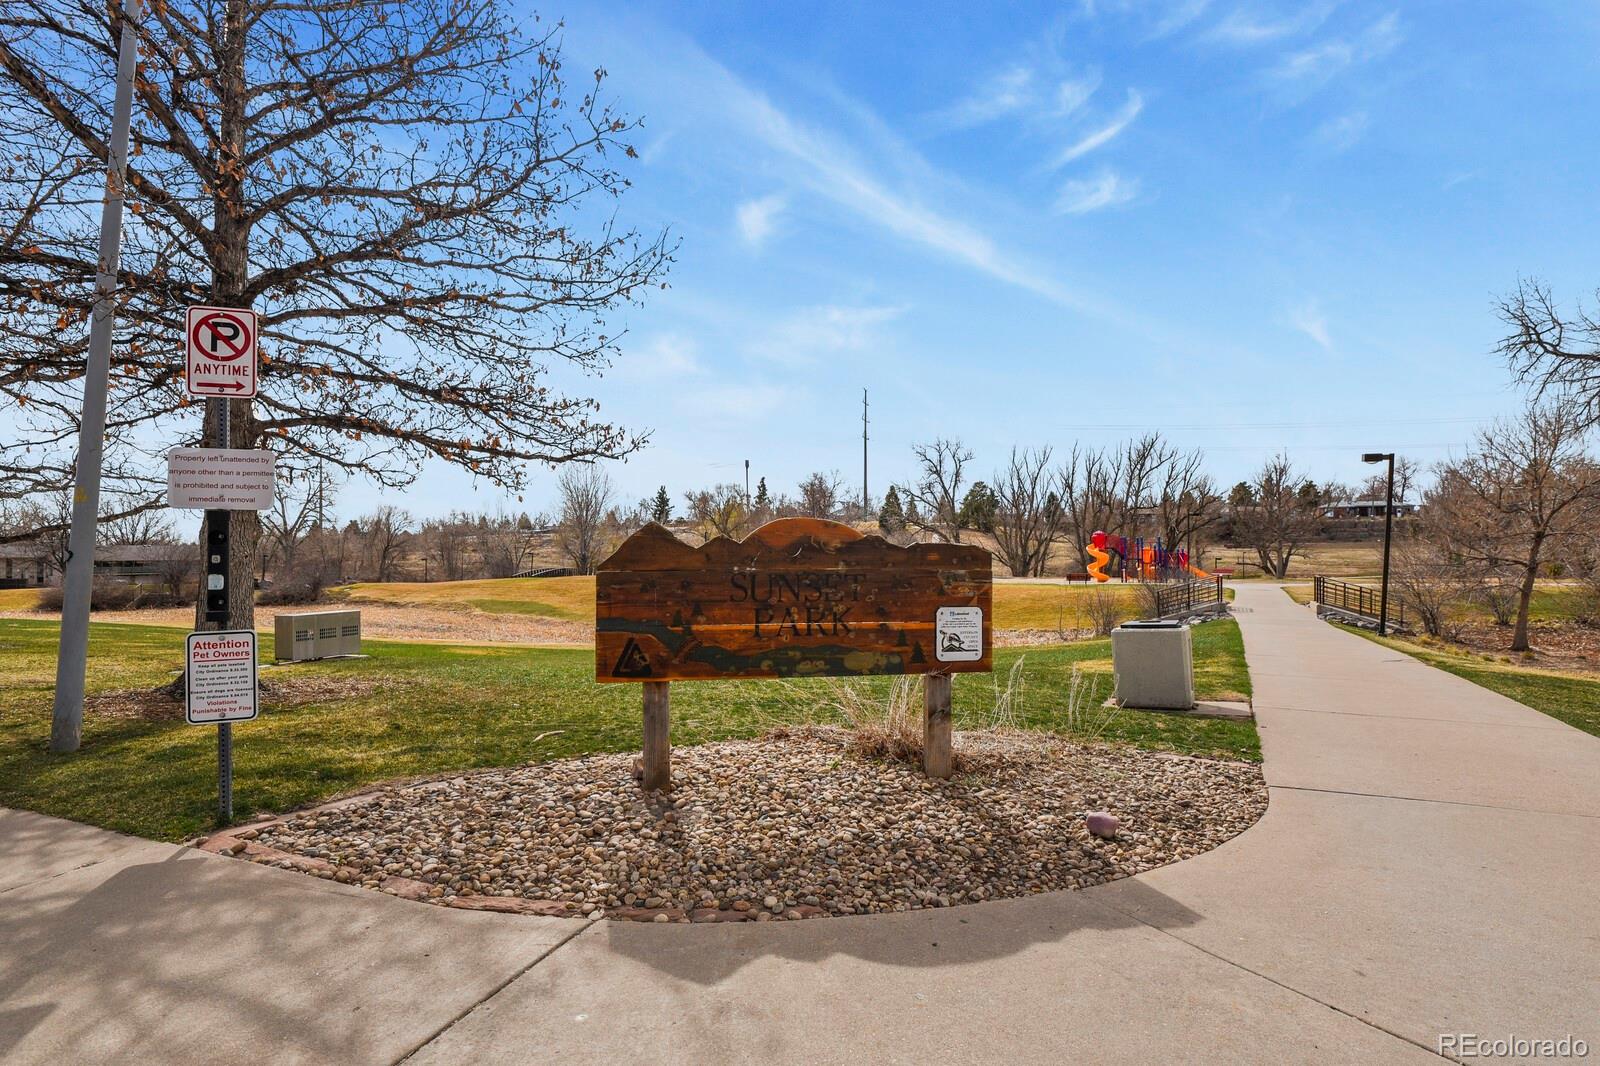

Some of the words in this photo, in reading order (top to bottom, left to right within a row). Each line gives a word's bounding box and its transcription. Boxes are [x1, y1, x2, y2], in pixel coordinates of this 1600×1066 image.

[194, 363, 249, 376] ANYTIME
[730, 572, 866, 602] SUNSET
[753, 606, 852, 638] PARK
[194, 640, 249, 650] Attention
